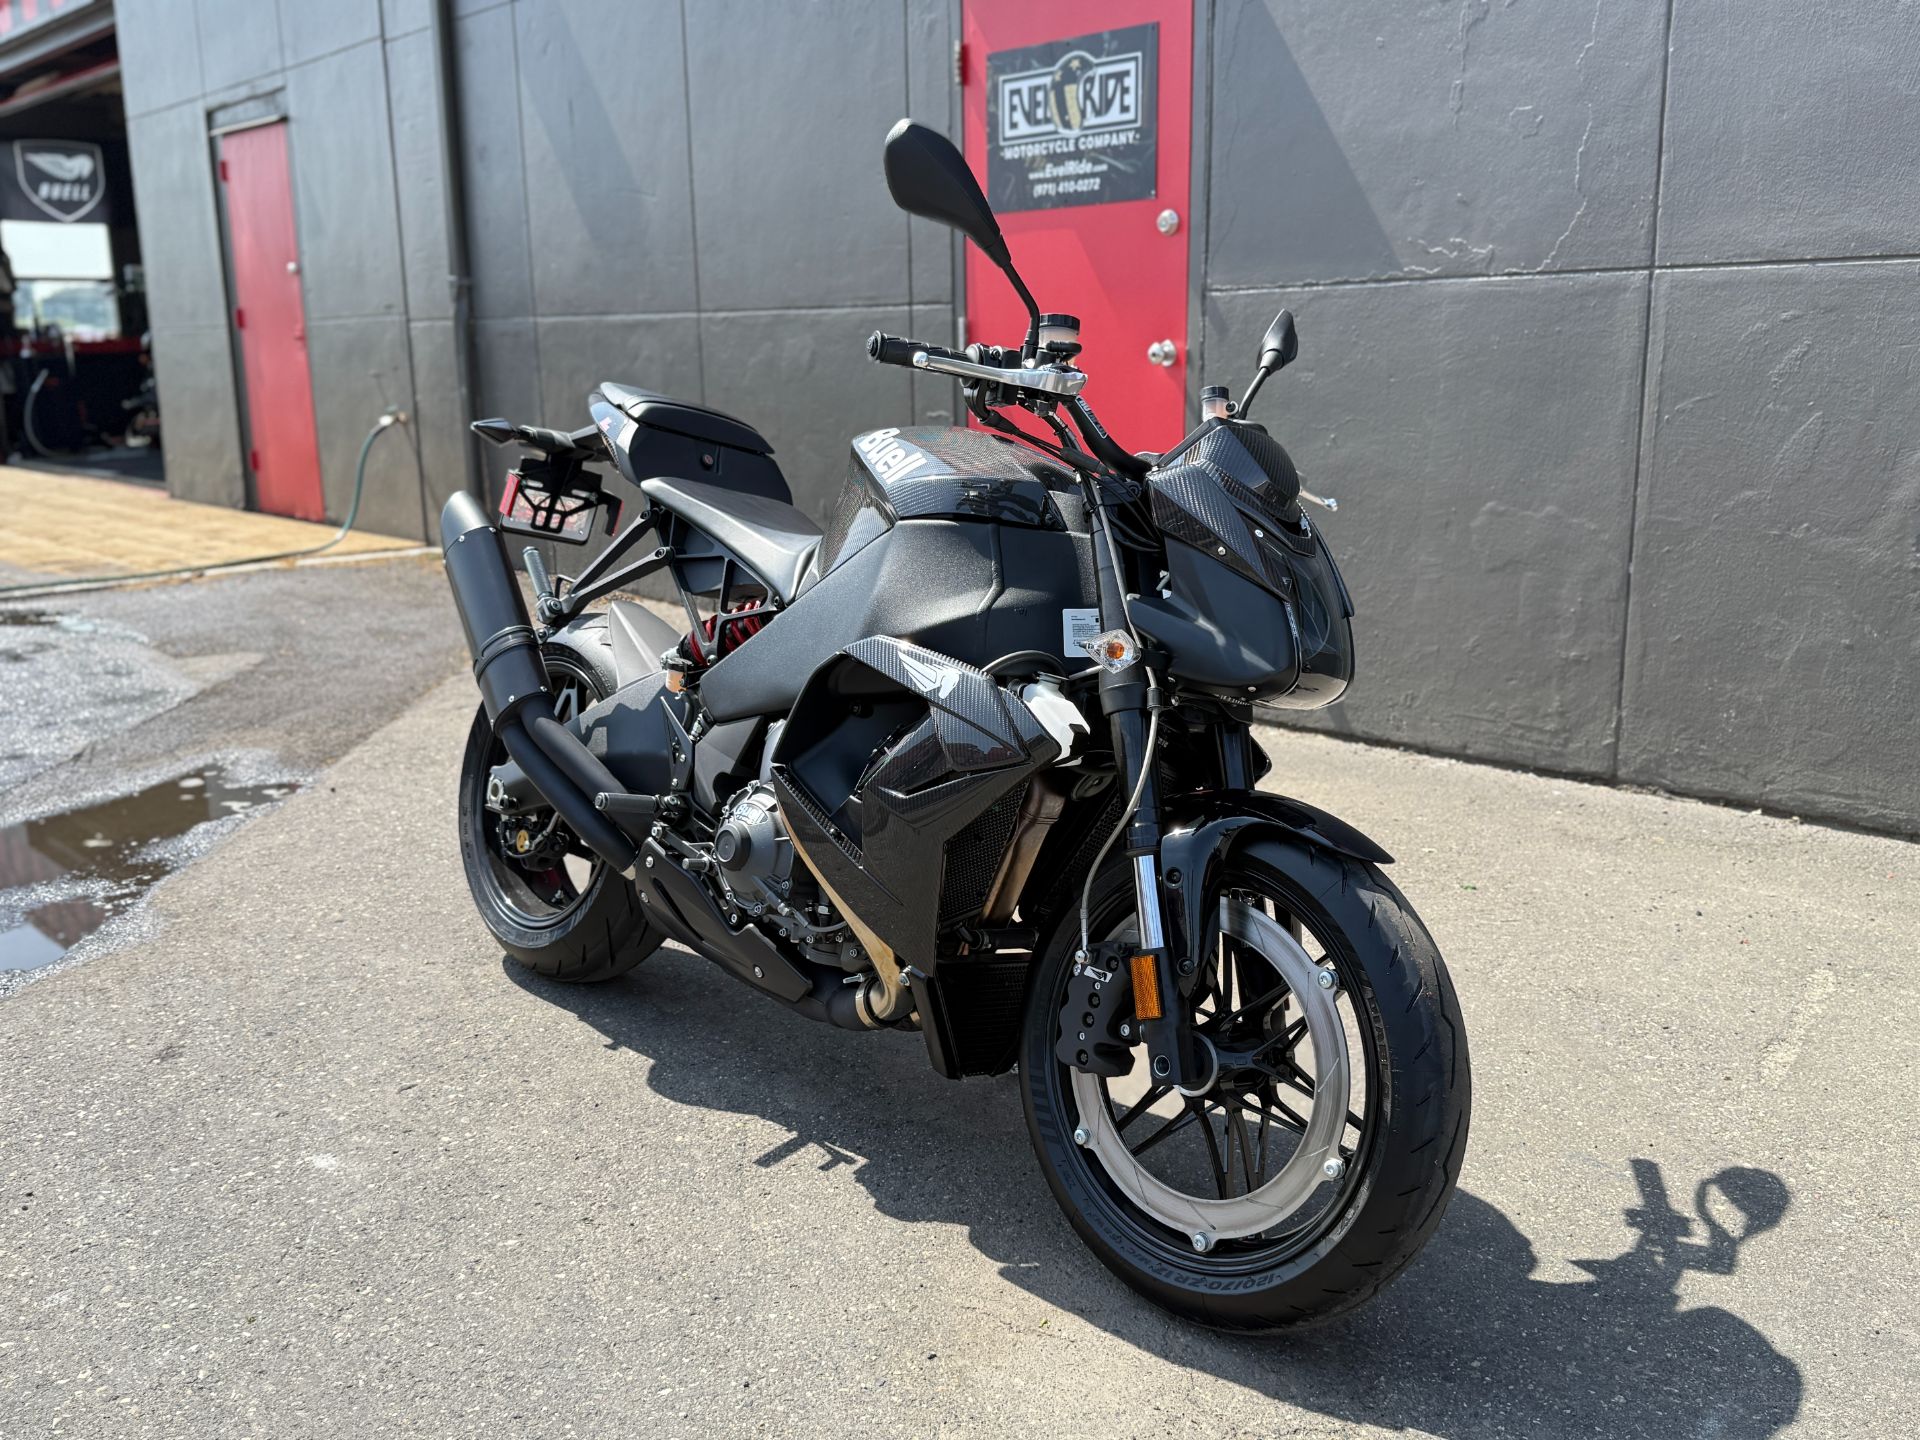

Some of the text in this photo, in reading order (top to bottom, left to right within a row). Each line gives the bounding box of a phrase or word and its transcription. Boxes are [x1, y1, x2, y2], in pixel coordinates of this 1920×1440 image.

[1080, 69, 1131, 121] RIDE
[1003, 131, 1134, 160] MOTORCYCLE COMPANY
[1033, 177, 1101, 198] (971) 410-0272
[858, 427, 928, 485] Buell
